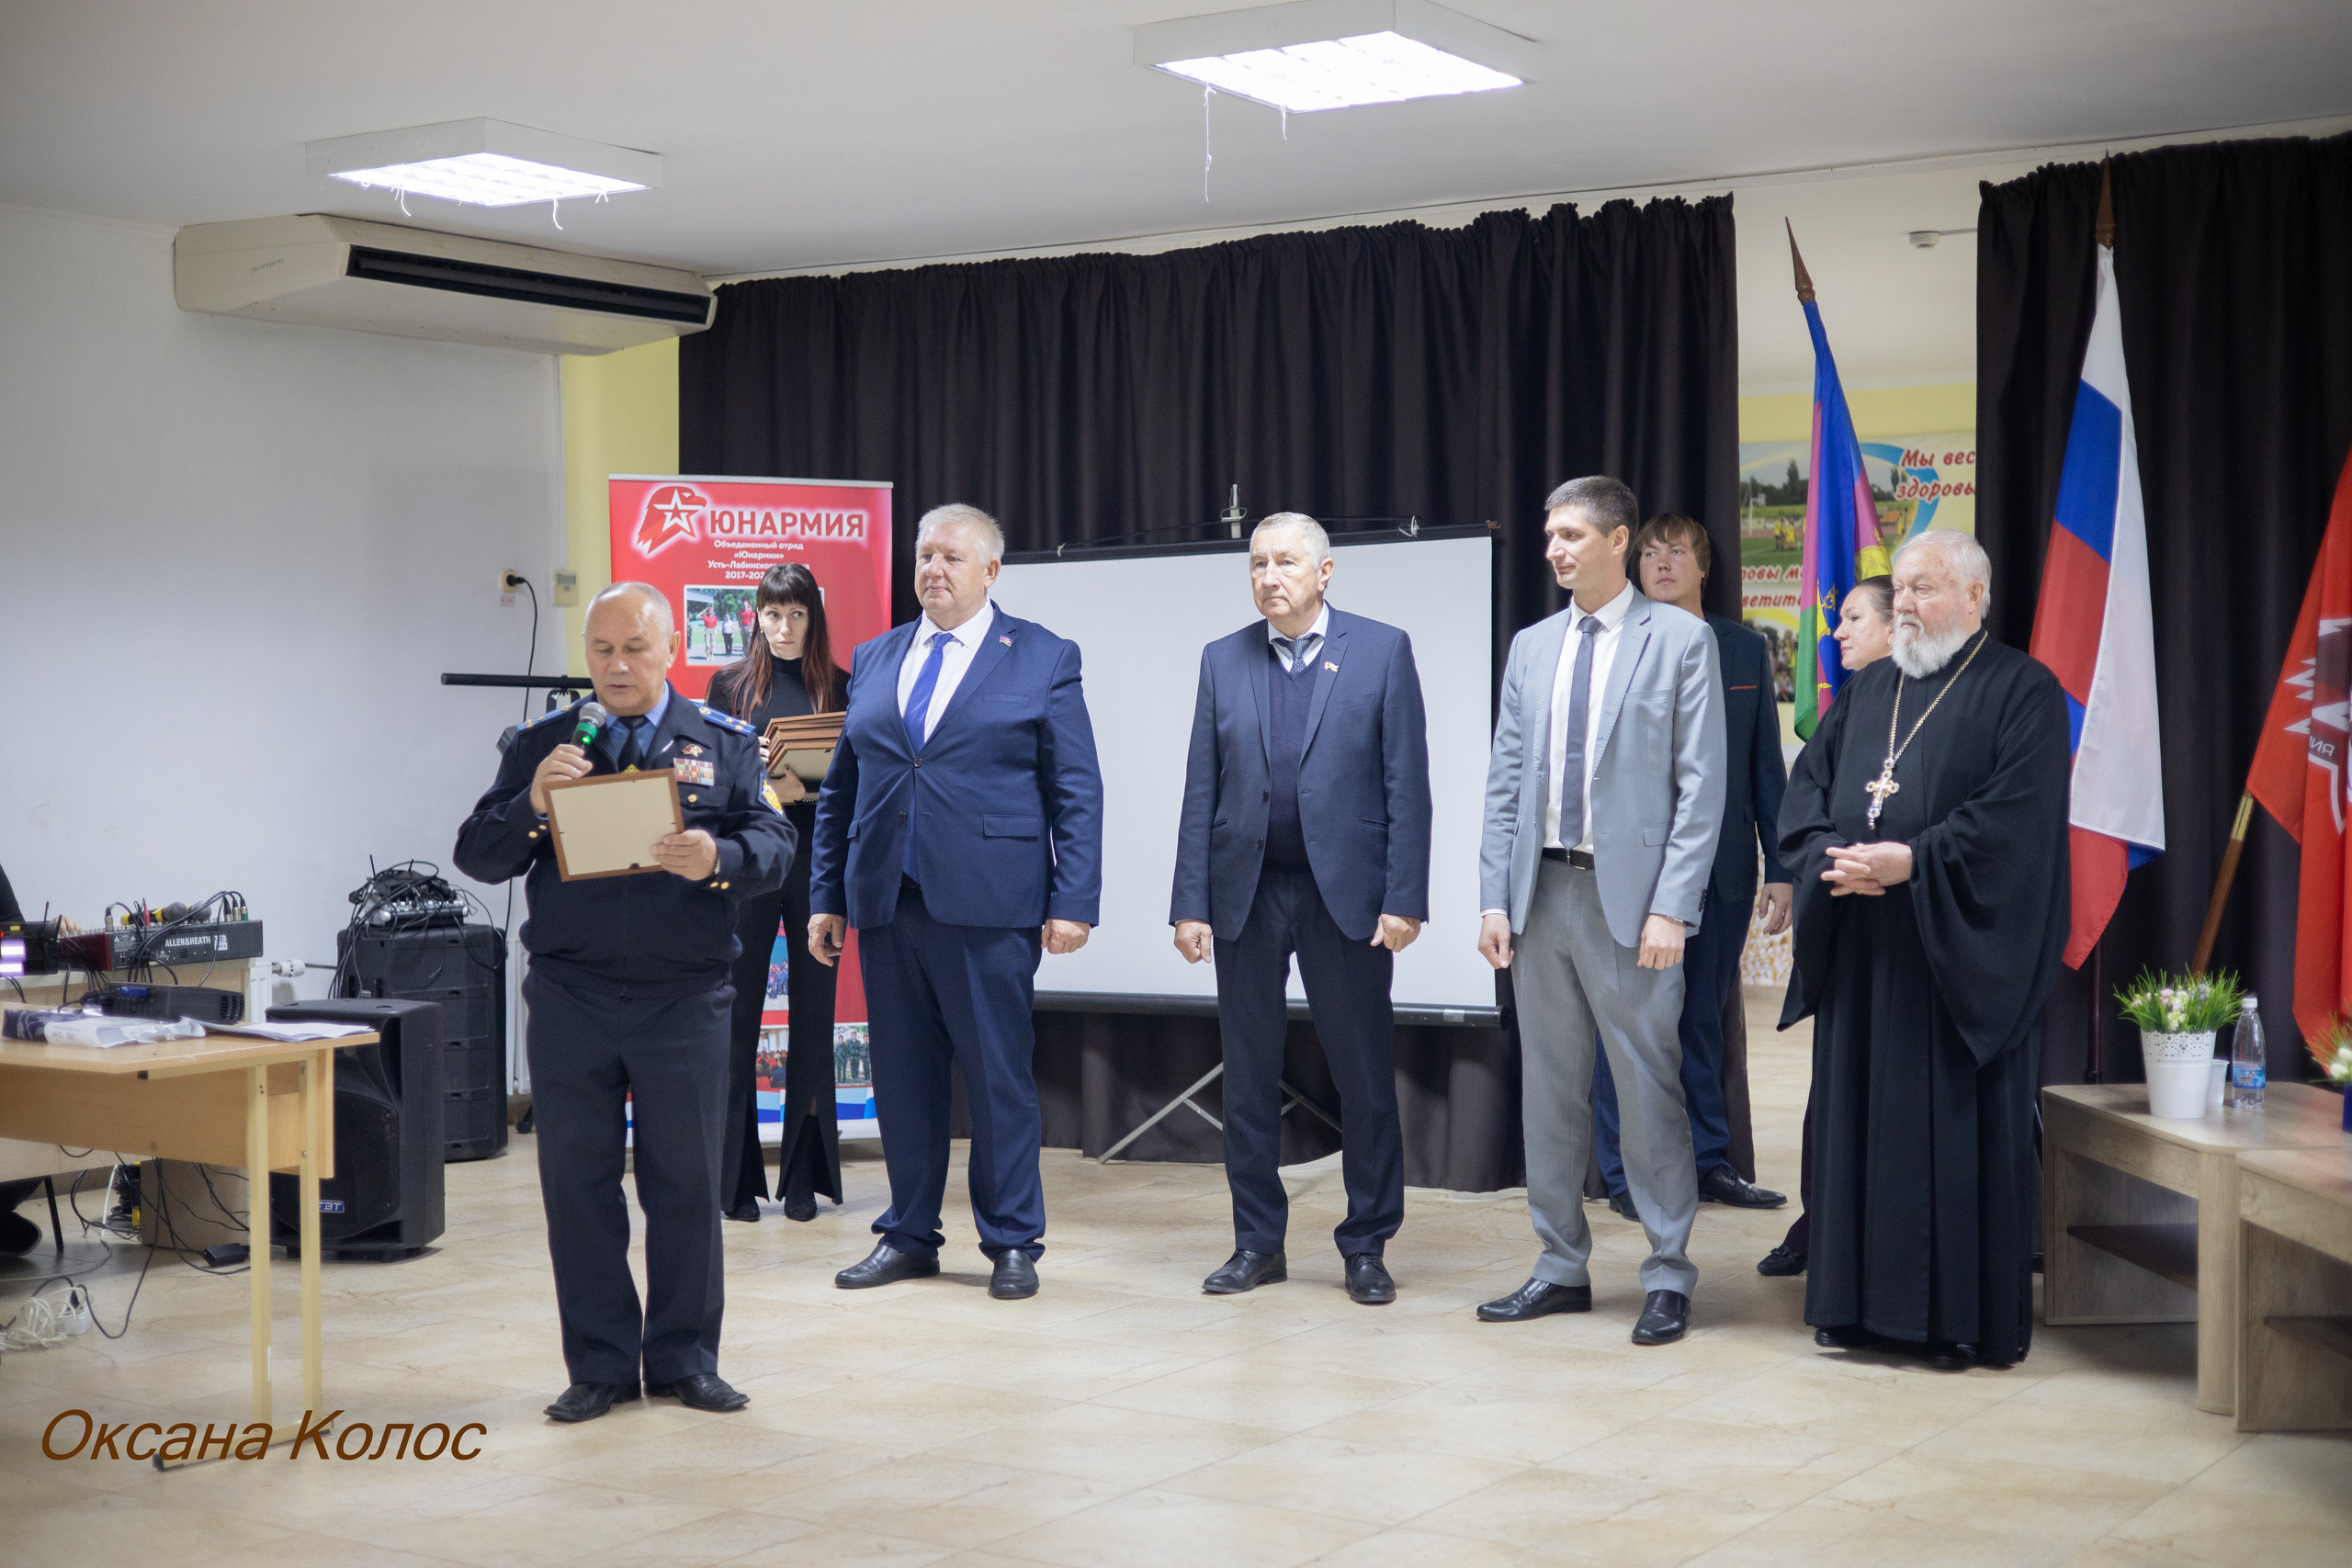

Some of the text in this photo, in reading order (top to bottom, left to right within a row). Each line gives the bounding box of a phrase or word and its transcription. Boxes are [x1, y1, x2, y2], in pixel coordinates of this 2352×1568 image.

[1900, 449, 1935, 468] Мы
[710, 510, 864, 537] ЮНАРМИЯ
[778, 542, 804, 551] отряд
[733, 550, 785, 560] «Юнармии»
[725, 570, 765, 580] 2017-202
[165, 935, 211, 947] ALLEN&HEATH
